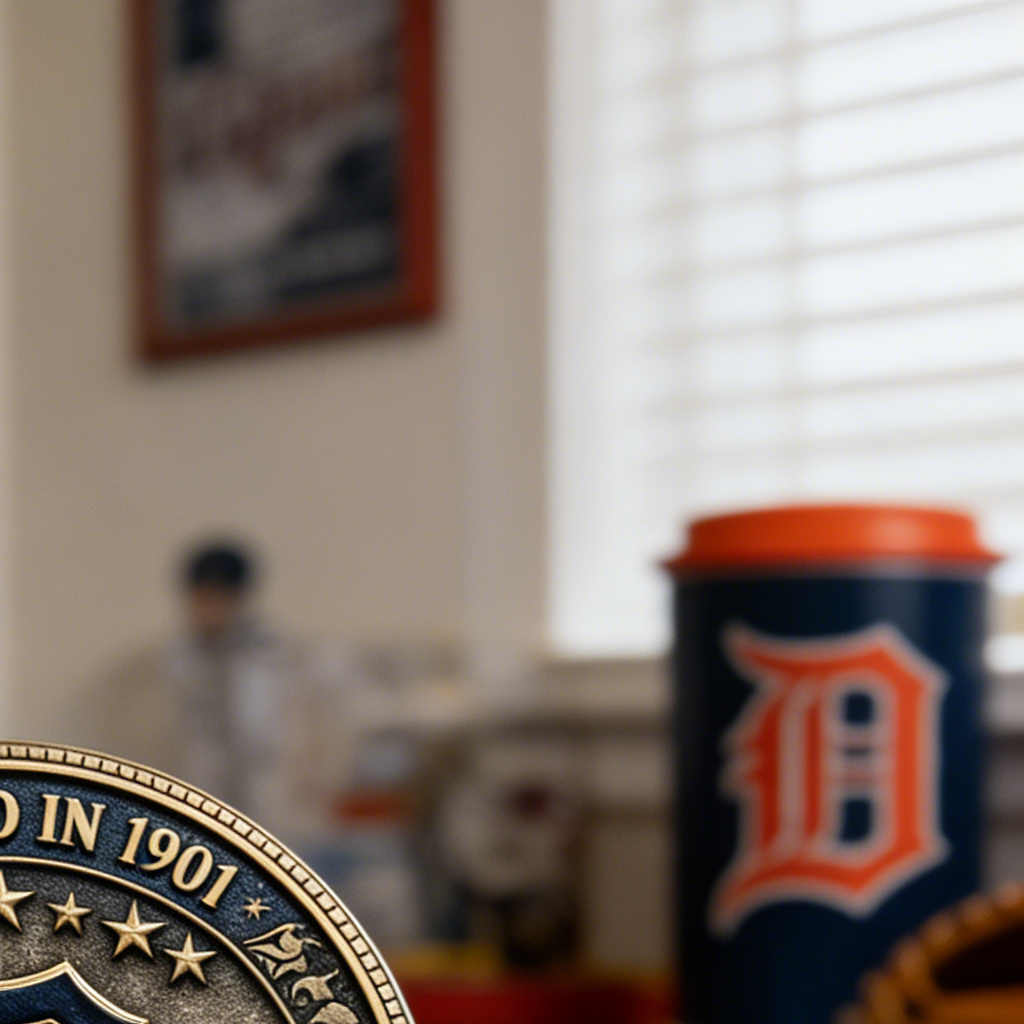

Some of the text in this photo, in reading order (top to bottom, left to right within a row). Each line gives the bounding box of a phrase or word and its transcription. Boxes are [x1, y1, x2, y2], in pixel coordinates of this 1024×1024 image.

[35, 792, 107, 853] IN
[117, 816, 240, 910] 1901
[708, 622, 952, 940] D
